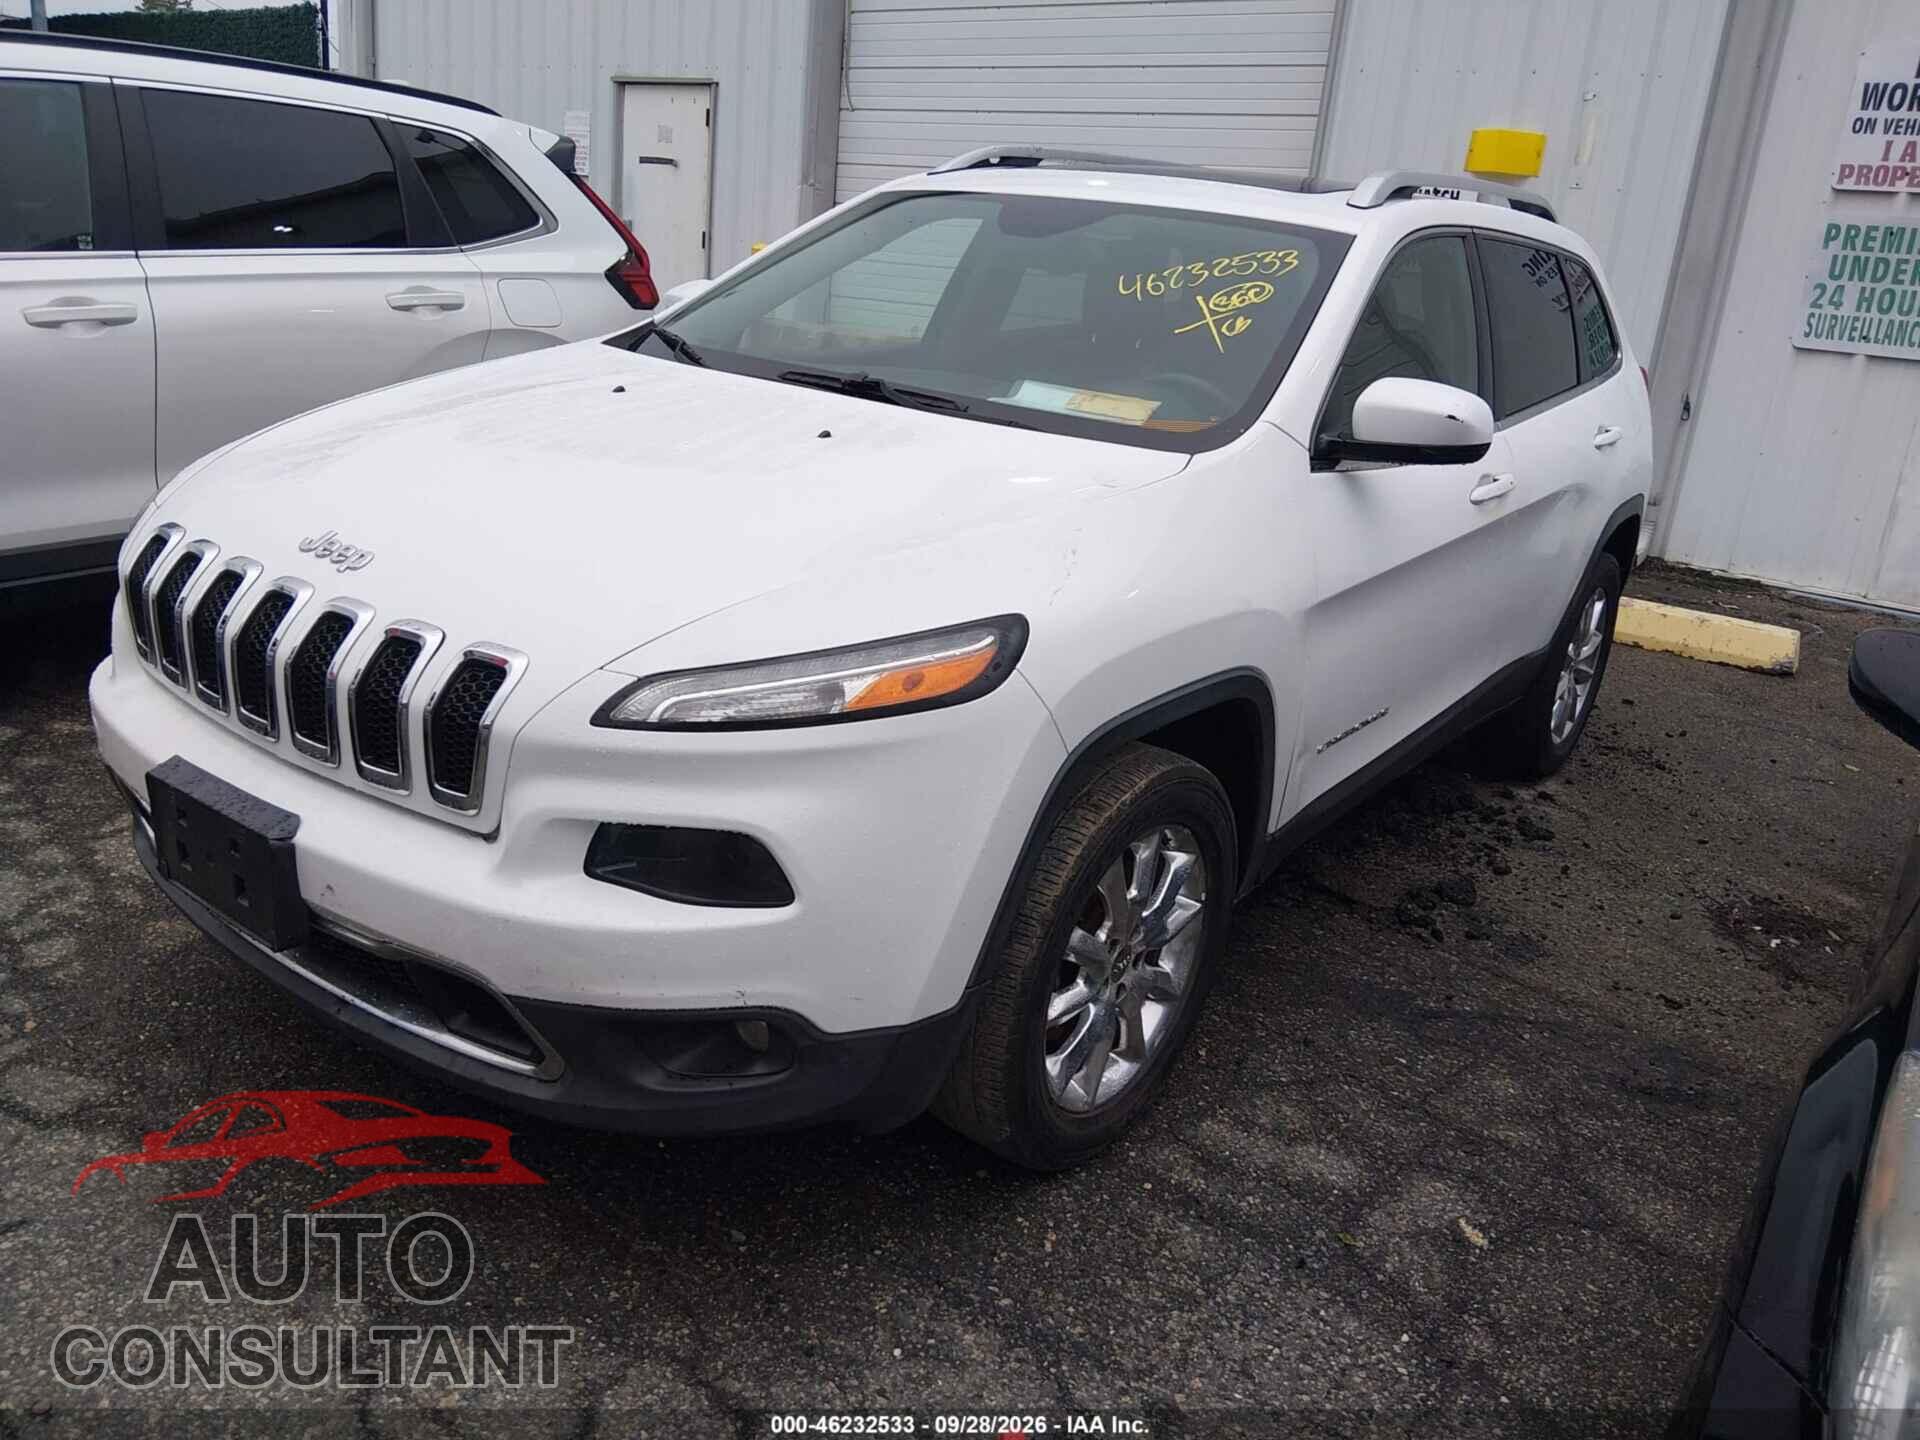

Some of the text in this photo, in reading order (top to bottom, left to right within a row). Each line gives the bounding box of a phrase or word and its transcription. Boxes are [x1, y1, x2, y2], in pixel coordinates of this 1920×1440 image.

[1852, 116, 1877, 134] ON
[1822, 223, 1920, 255] PREMI
[1809, 282, 1920, 317] 24 HOU
[1803, 312, 1920, 348] SURVEILLANC
[298, 529, 375, 573] Jeep
